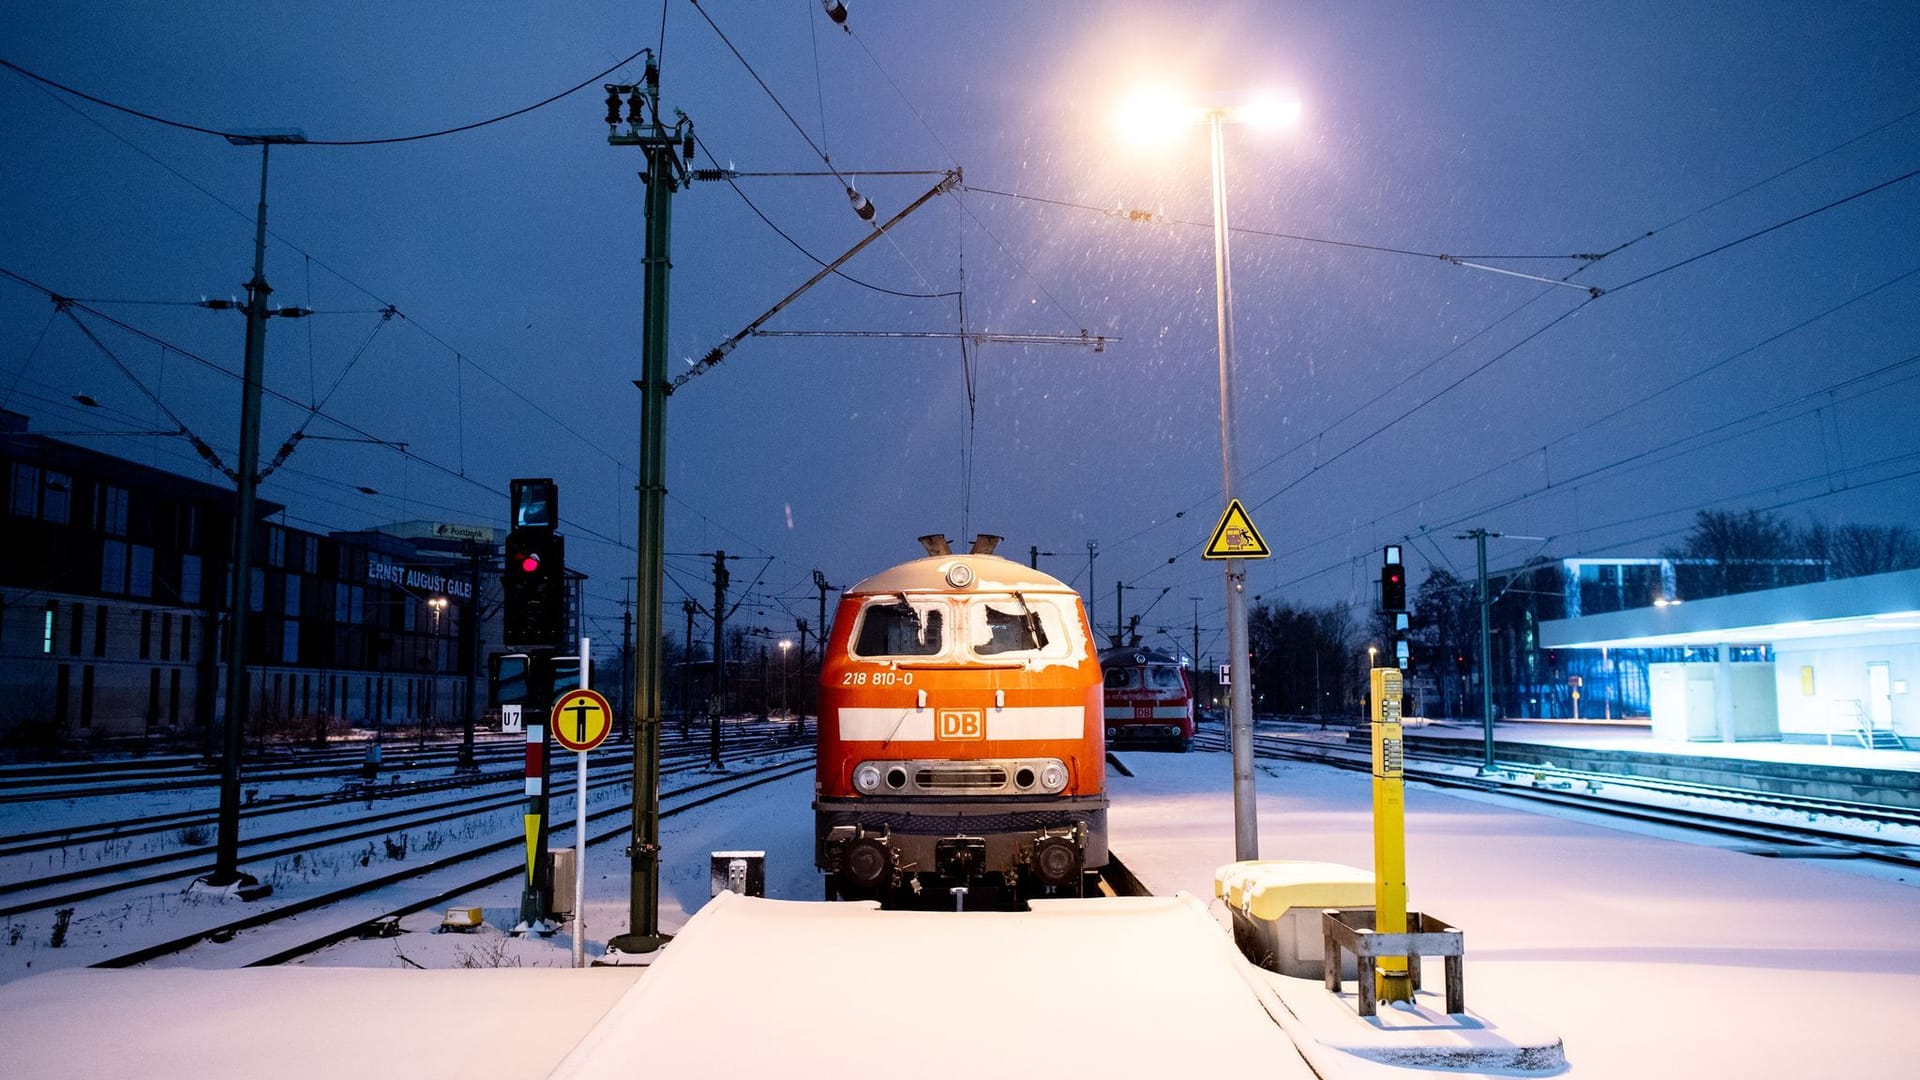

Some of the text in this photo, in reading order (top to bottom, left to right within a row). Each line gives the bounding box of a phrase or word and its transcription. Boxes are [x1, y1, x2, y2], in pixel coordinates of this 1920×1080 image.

[450, 527, 483, 537] Postbank
[368, 560, 472, 598] ERNST AUGUST GALE
[843, 672, 913, 685] 218 810-0
[1137, 709, 1151, 717] DB
[942, 712, 979, 737] DB
